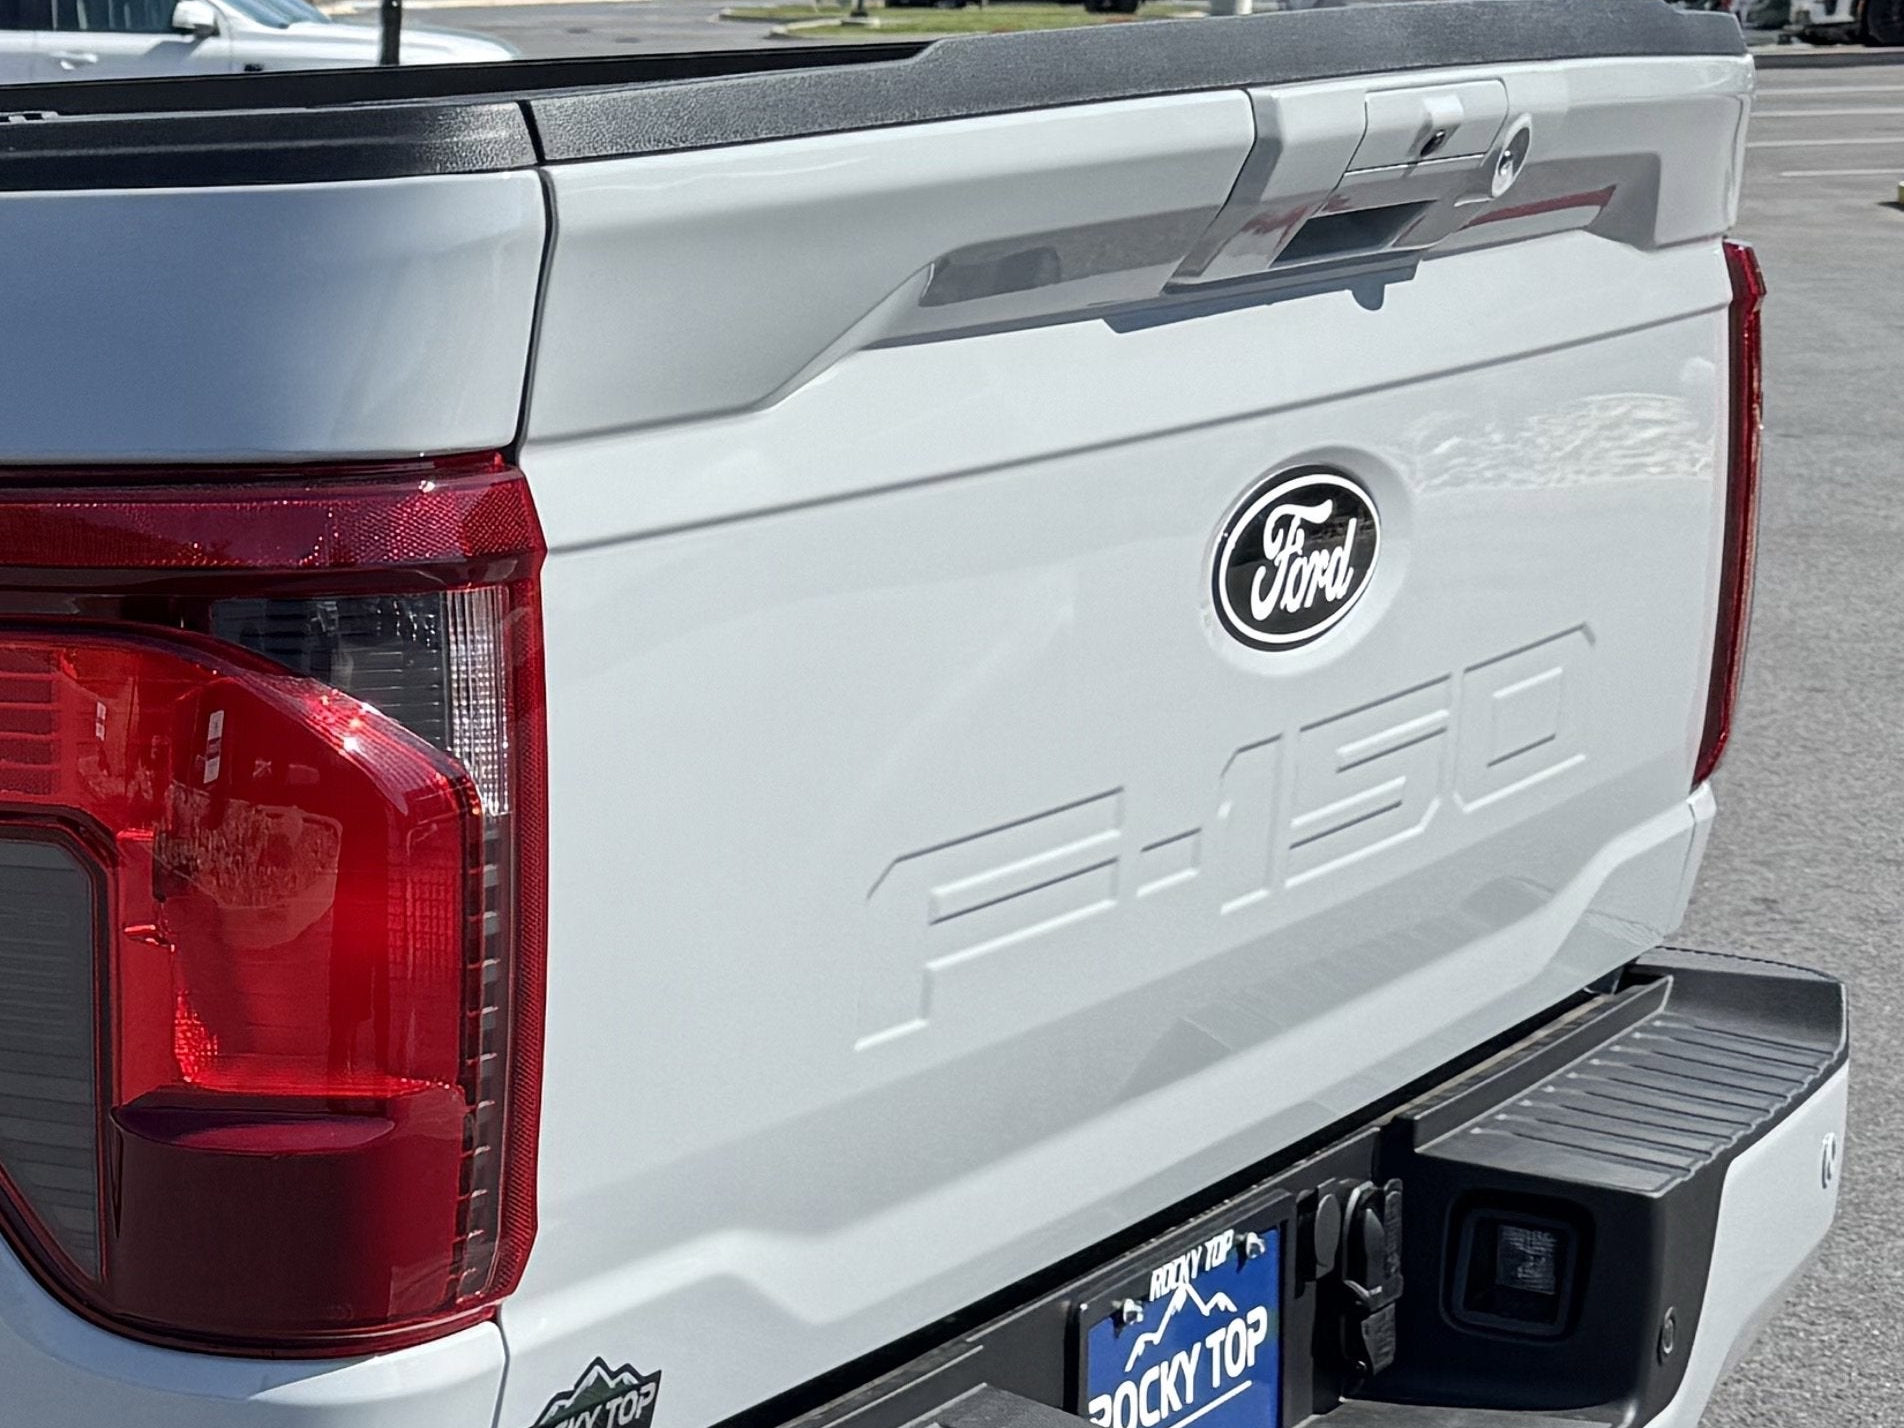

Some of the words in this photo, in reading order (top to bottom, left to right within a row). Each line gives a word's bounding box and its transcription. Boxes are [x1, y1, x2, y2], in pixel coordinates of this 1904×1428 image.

[1248, 499, 1360, 622] Ford
[853, 622, 1596, 1052] F-150
[1149, 1246, 1202, 1302] ROCKY
[1204, 1228, 1235, 1272] TOP
[1205, 1305, 1268, 1389] TOP
